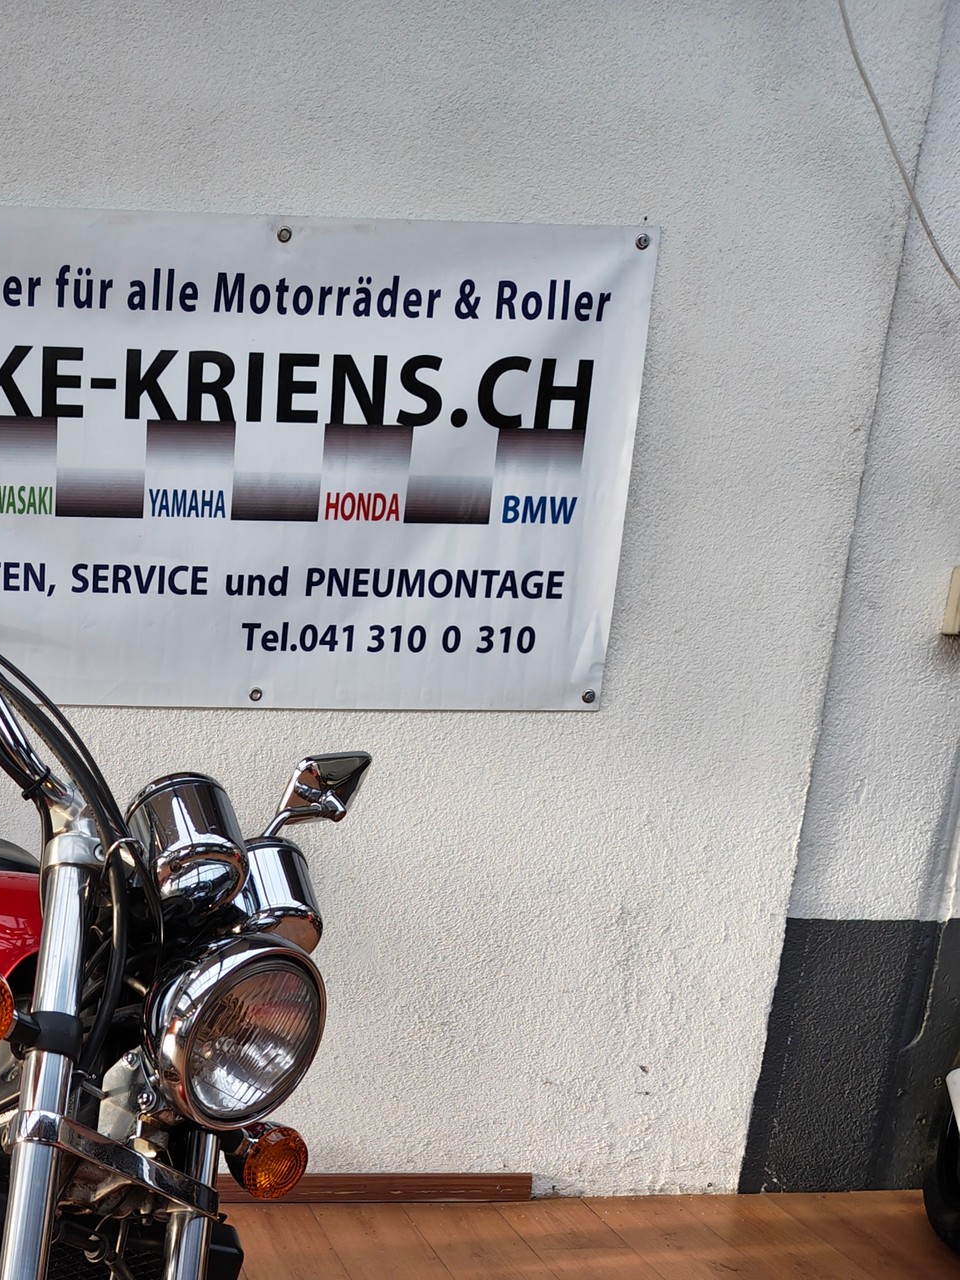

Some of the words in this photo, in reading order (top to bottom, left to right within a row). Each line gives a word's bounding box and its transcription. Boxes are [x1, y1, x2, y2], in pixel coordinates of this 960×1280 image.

[55, 264, 114, 310] für
[126, 267, 199, 313] alle
[213, 271, 442, 319] Motorräder
[454, 278, 482, 320] &
[495, 279, 612, 323] Roller
[148, 488, 226, 519] YAMAHA
[324, 491, 400, 522] HONDA
[501, 494, 578, 525] BMW
[71, 562, 209, 596] SERVICE
[225, 565, 290, 597] und
[304, 567, 565, 600] PNEUMONTAGE
[366, 624, 427, 654] 310
[441, 625, 462, 654] 0
[475, 625, 536, 654] 310
